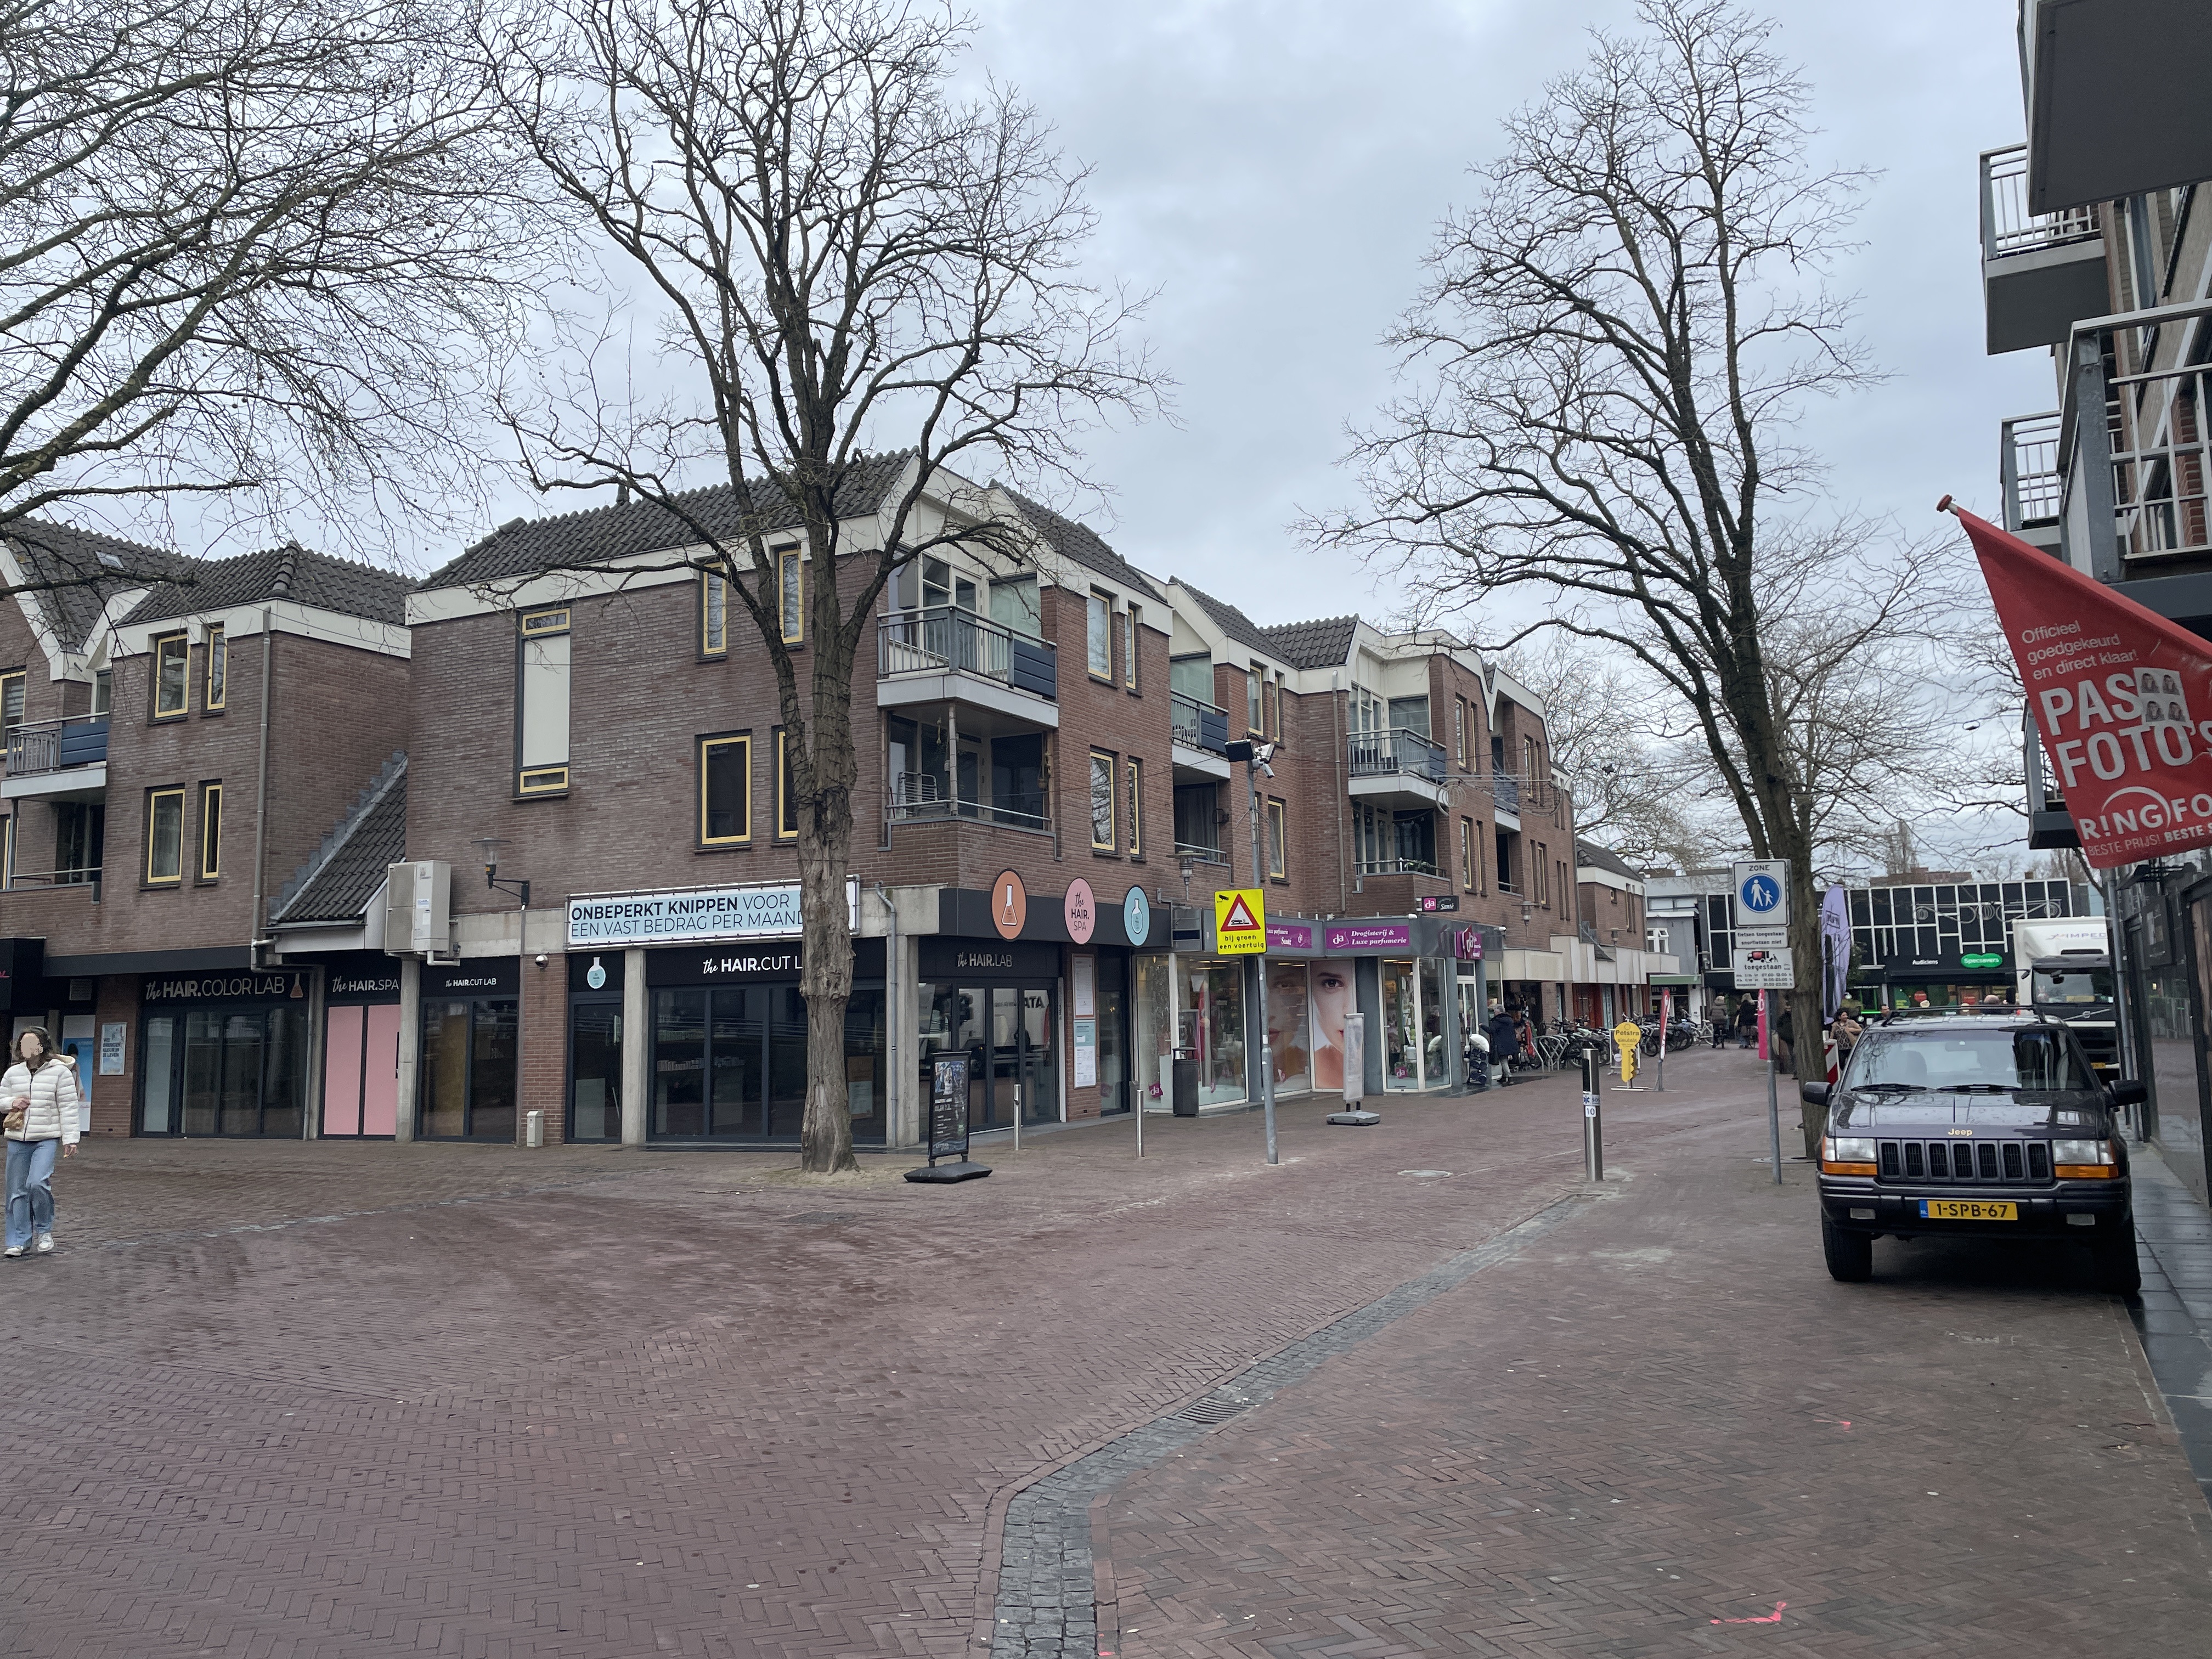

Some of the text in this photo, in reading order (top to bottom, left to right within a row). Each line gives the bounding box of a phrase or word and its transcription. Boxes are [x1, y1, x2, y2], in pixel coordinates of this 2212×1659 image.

[2022, 620, 2081, 644] Officieel
[2027, 634, 2121, 665] goedgekeurd
[2033, 649, 2139, 680] en direct klaar!
[2039, 673, 2142, 736] PAS
[2087, 842, 2123, 856] BESTE
[2125, 834, 2161, 850] PRIJS!
[2164, 825, 2205, 842] BESTE
[1075, 891, 1085, 907] the
[1425, 900, 1435, 909] da
[572, 894, 789, 921] ONBEPERKT KNIPPEN VOOR
[1071, 909, 1090, 919] HAIR.
[572, 923, 599, 936] EEN
[604, 920, 639, 935] VAST
[644, 916, 707, 933] BEDRAG
[713, 914, 742, 928] PER
[1074, 921, 1087, 932] SPA
[1333, 934, 1344, 944] da
[1369, 937, 1407, 945] parfumerie
[703, 957, 718, 974] the
[957, 952, 968, 967] the
[146, 981, 162, 1000] the
[255, 977, 284, 994] LAB
[332, 975, 347, 992] the
[1396, 1068, 1405, 1076] da
[1150, 1086, 1159, 1095] da
[1937, 1203, 2007, 1217] 1-SPB-67
